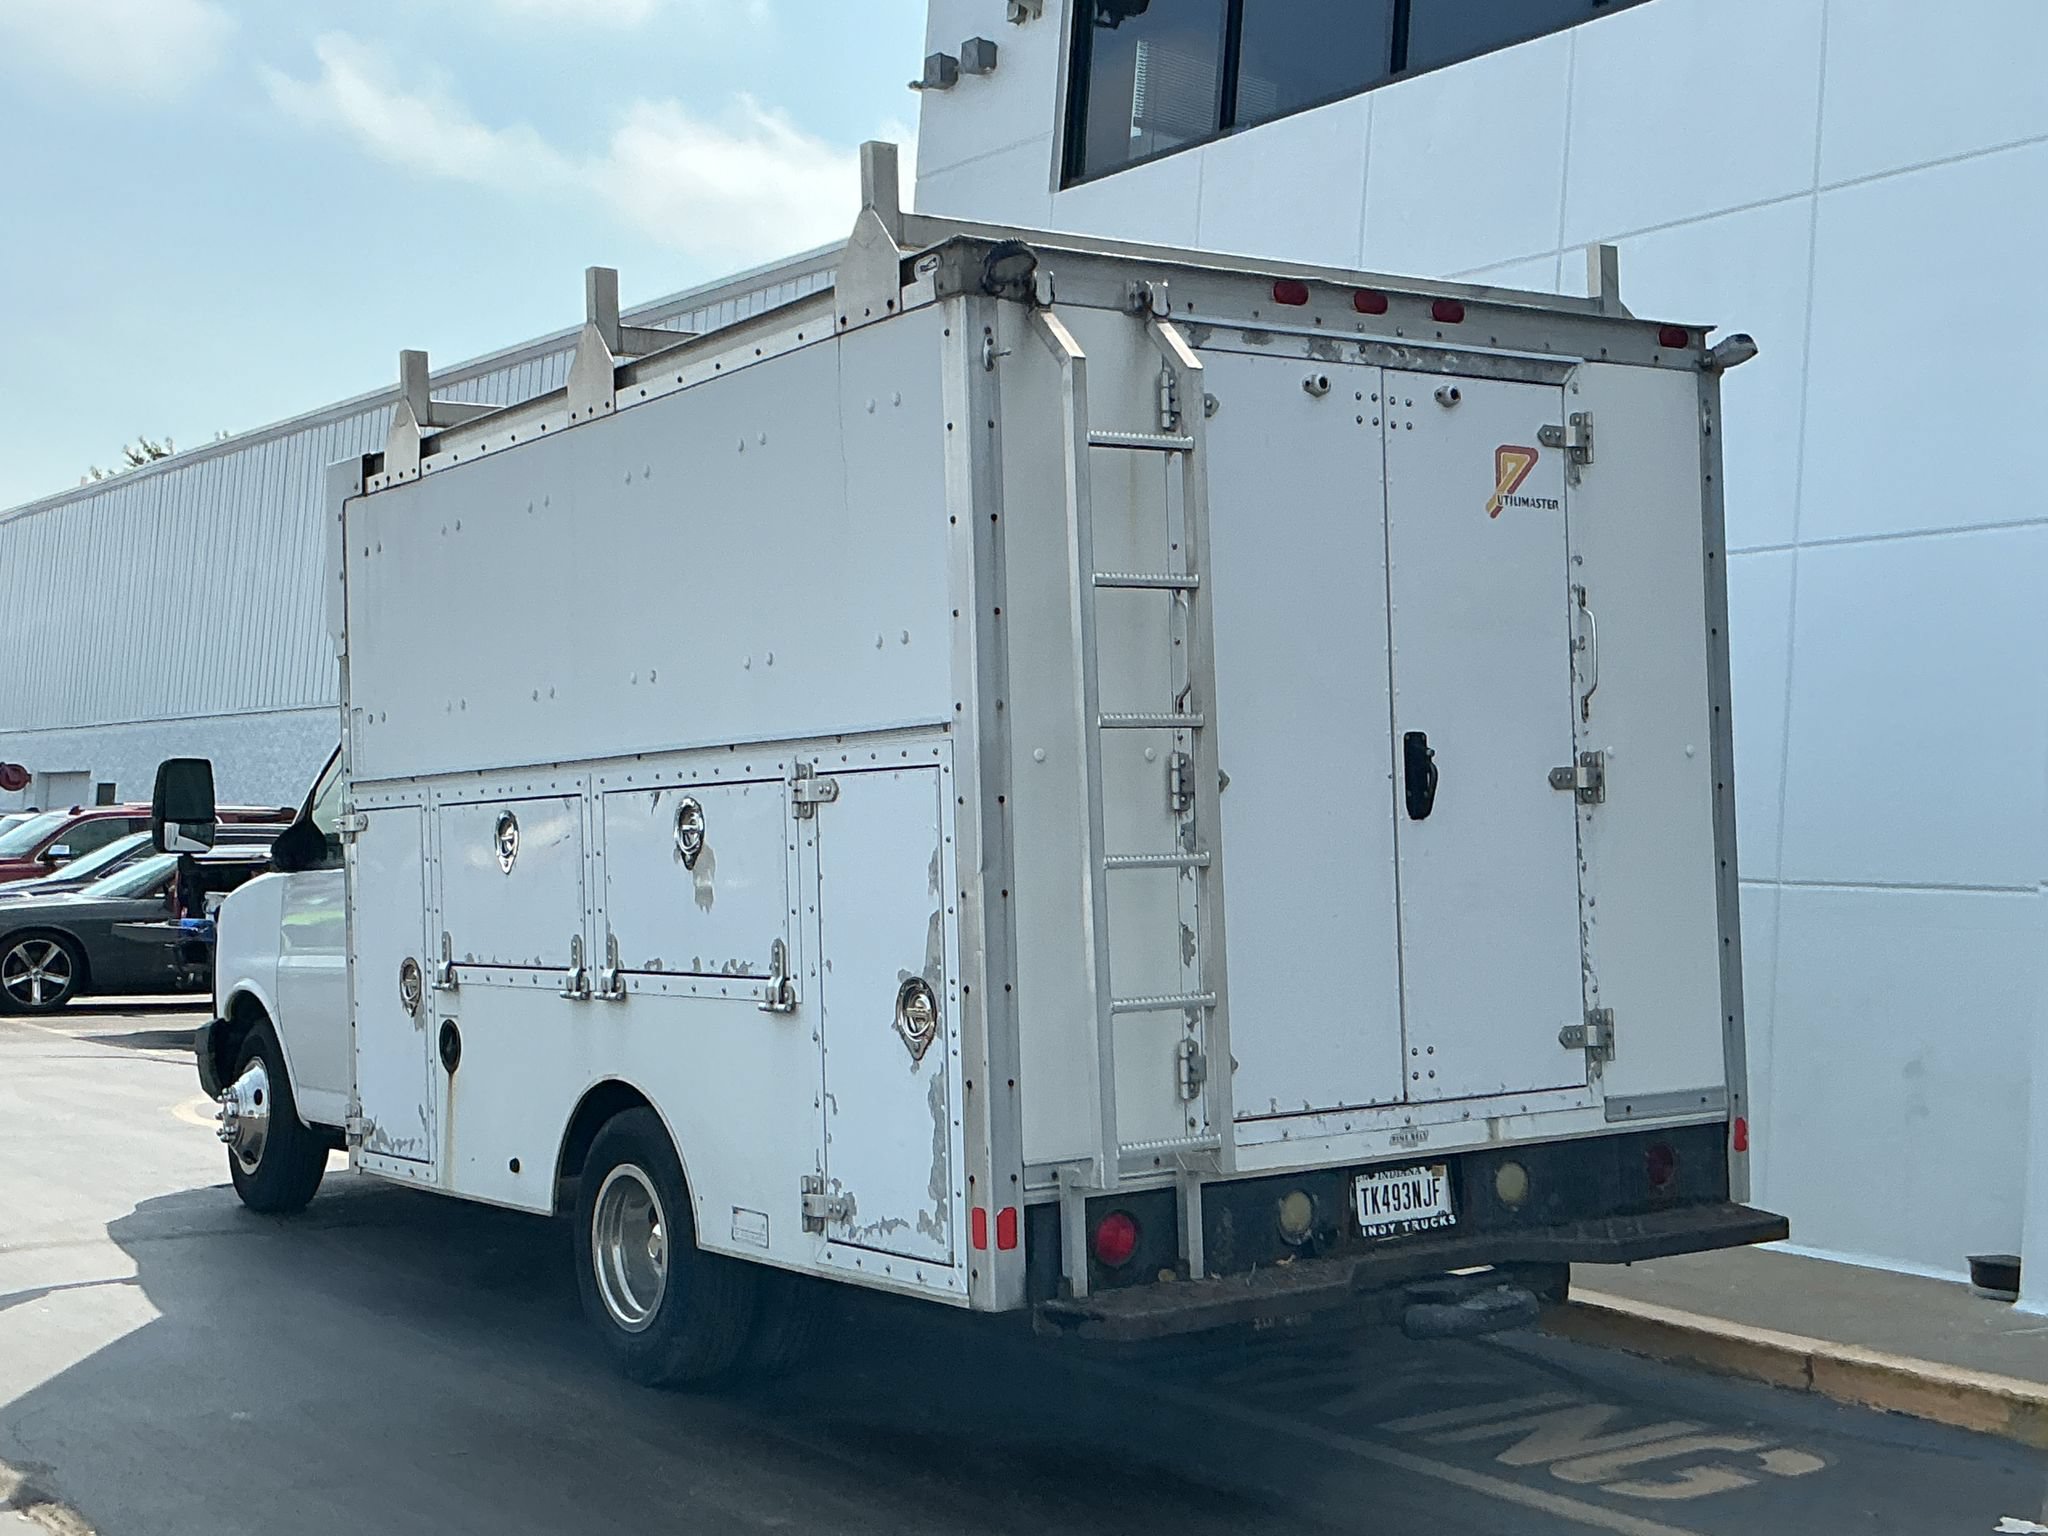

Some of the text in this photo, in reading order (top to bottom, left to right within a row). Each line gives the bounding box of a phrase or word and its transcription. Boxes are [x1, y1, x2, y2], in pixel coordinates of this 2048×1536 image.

[1497, 494, 1559, 510] UTILIMASTER
[1378, 1167, 1421, 1180] INDIANA
[1361, 1178, 1440, 1216] TK493NJF
[1362, 1215, 1456, 1237] INDY TRUCKS
